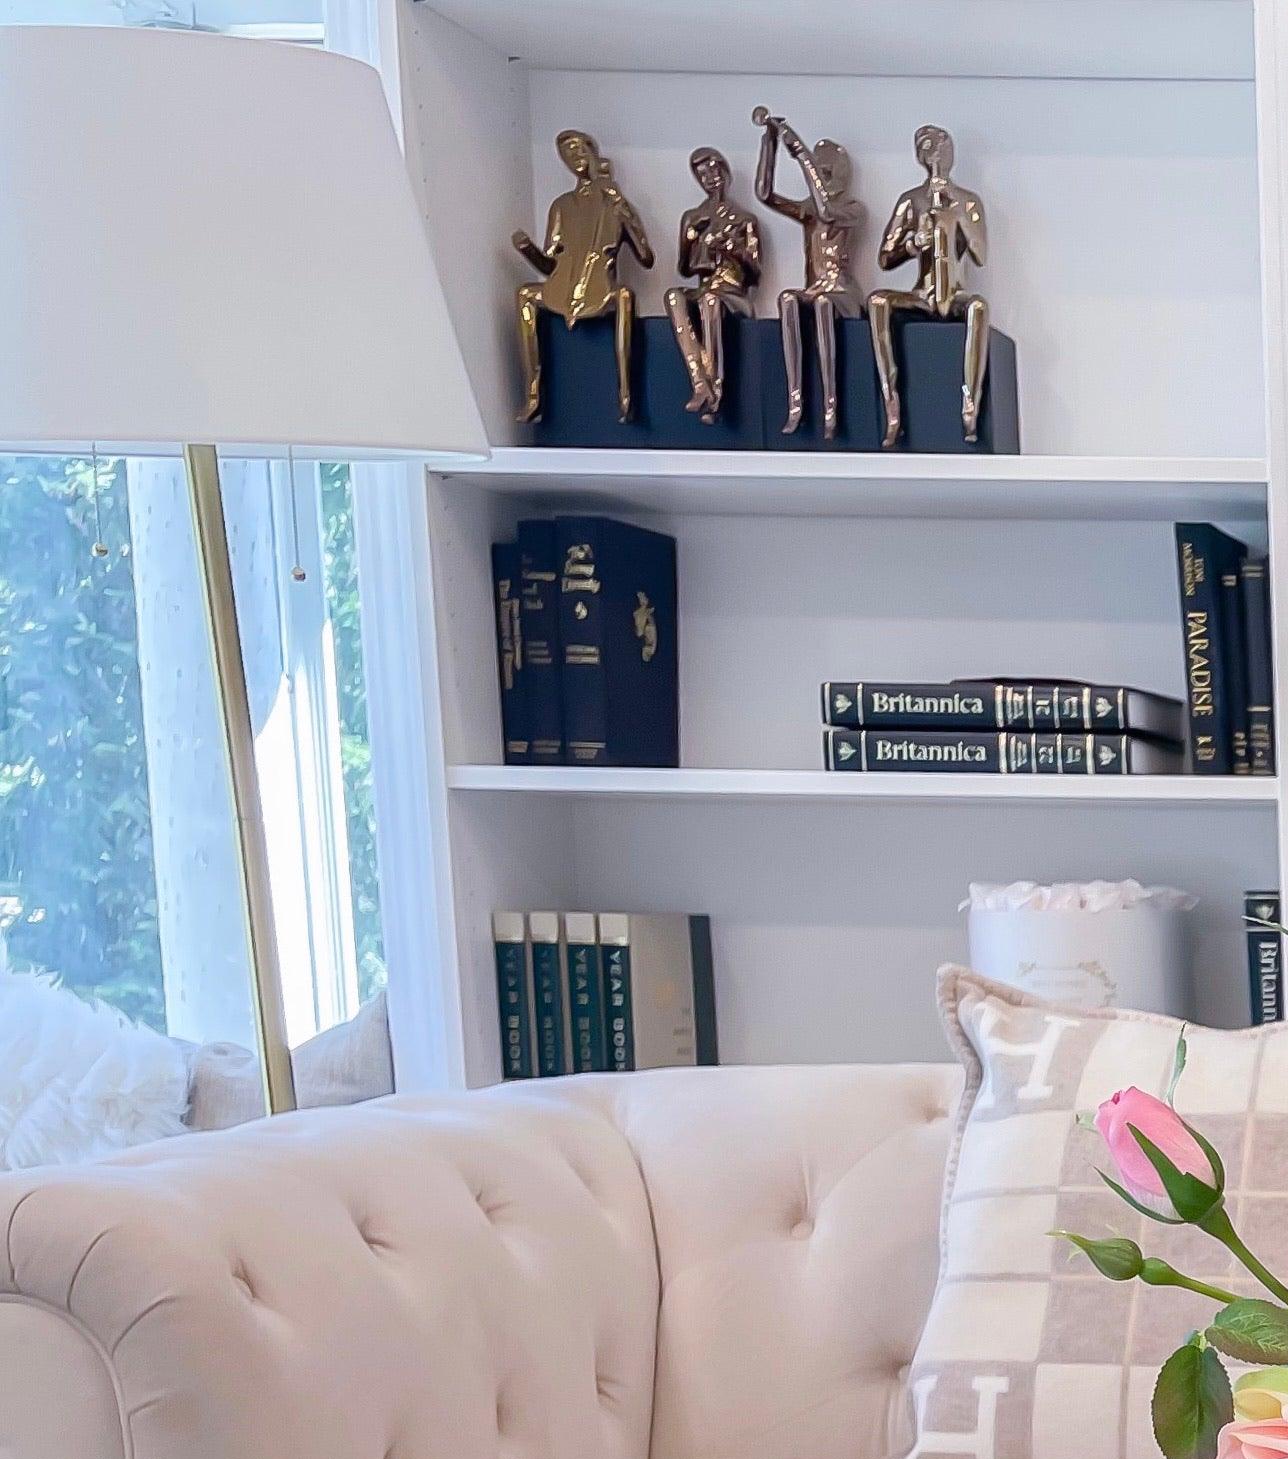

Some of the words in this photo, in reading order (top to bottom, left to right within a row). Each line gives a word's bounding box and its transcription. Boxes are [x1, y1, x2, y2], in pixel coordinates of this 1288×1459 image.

[871, 693, 984, 715] Britannica
[1187, 611, 1214, 717] PARADISE
[875, 740, 987, 762] Britannica
[1258, 941, 1278, 1024] Britann
[976, 1005, 1083, 1101] H
